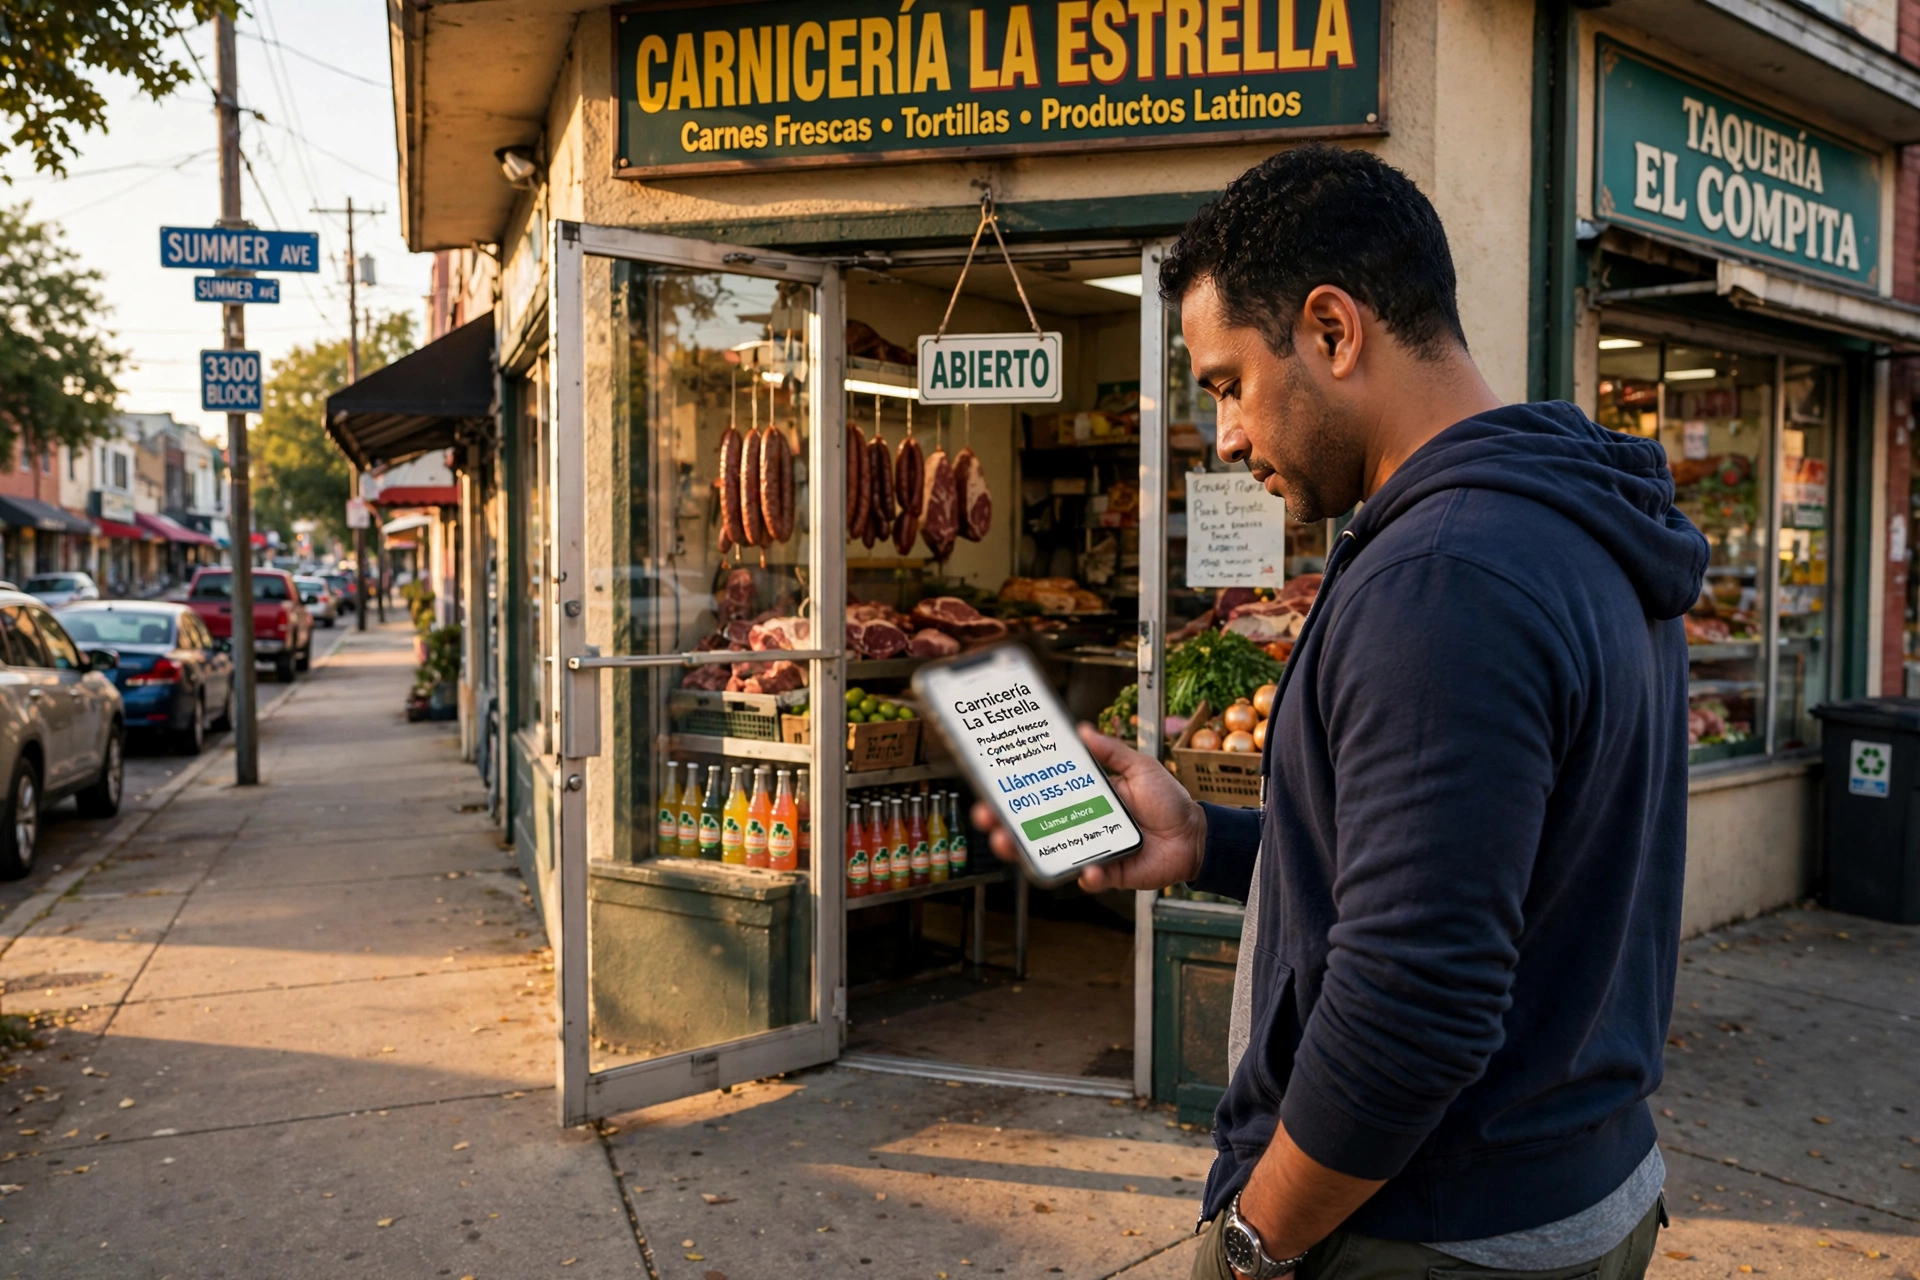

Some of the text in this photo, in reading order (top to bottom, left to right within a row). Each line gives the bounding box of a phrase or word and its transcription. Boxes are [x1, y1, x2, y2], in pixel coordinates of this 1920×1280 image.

[636, 0, 1357, 114] CARNICERÍA LA ESTRELLA
[681, 85, 1302, 153] Carnes Frescas Tortillas Productos Latinos
[1682, 96, 1824, 195] TAQUERÍA
[1633, 141, 1860, 272] EL COMPITA
[168, 232, 312, 266] SUMMER AVE
[198, 280, 277, 299] SUMMER AVE
[205, 356, 258, 382] 3300
[930, 348, 1049, 389] ABIERTO
[206, 383, 258, 404] BLOCK
[954, 683, 1031, 714] Carnicería
[962, 699, 1041, 731] La Estrella
[976, 719, 1049, 746] Productos frescos
[1015, 737, 1027, 747] de
[997, 760, 1076, 793] Llámanos
[1008, 773, 1095, 814] (901) 555-1024
[1039, 806, 1094, 831] Llamar ahora
[1038, 843, 1068, 858] Abierto
[1068, 836, 1084, 846] hoy
